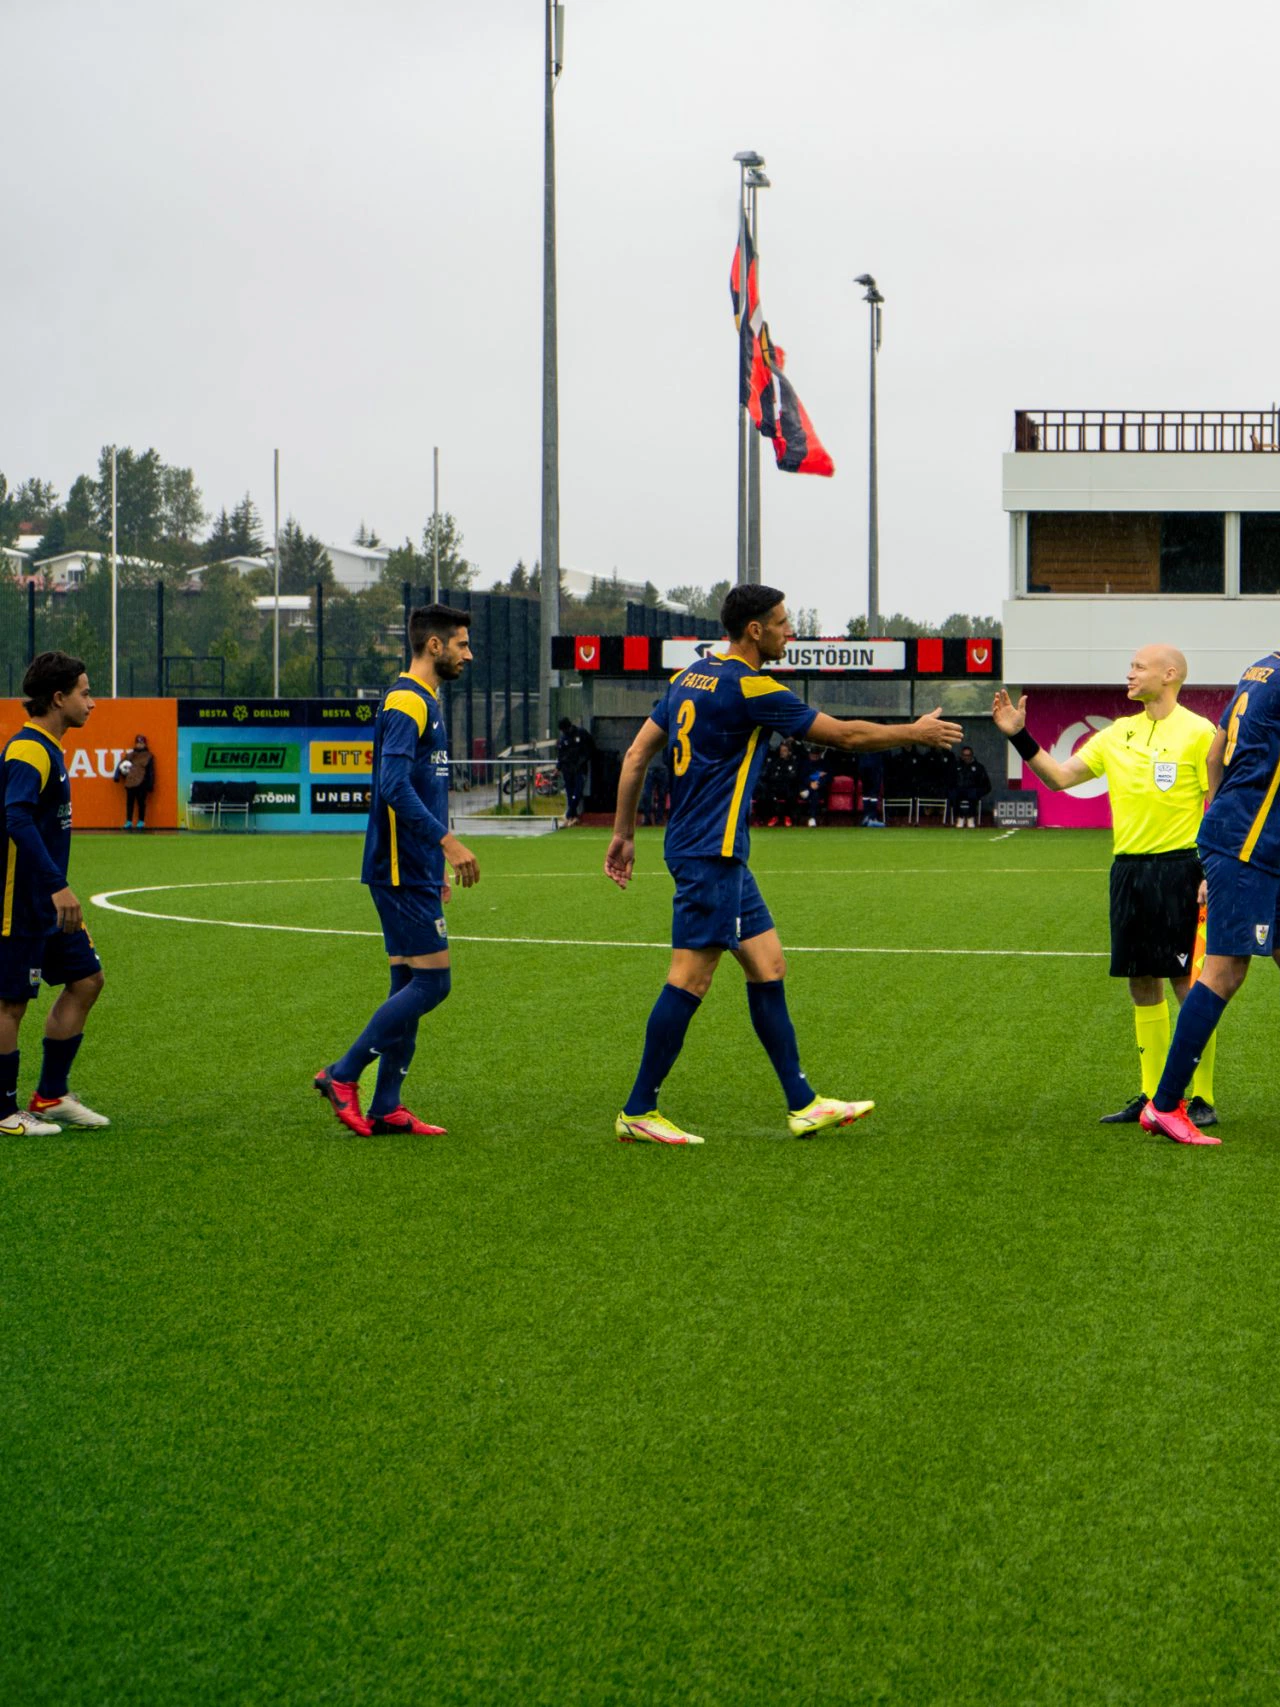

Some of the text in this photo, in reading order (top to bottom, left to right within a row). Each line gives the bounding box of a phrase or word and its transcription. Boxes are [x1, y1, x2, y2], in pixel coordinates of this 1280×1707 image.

[776, 645, 874, 666] USTÖÐIN
[199, 709, 290, 718] BESTA DEILDIN
[322, 709, 351, 718] BESTA
[1223, 691, 1249, 766] 6
[673, 699, 696, 777] 3
[210, 750, 281, 766] LENGJAN
[322, 750, 363, 766] EITT
